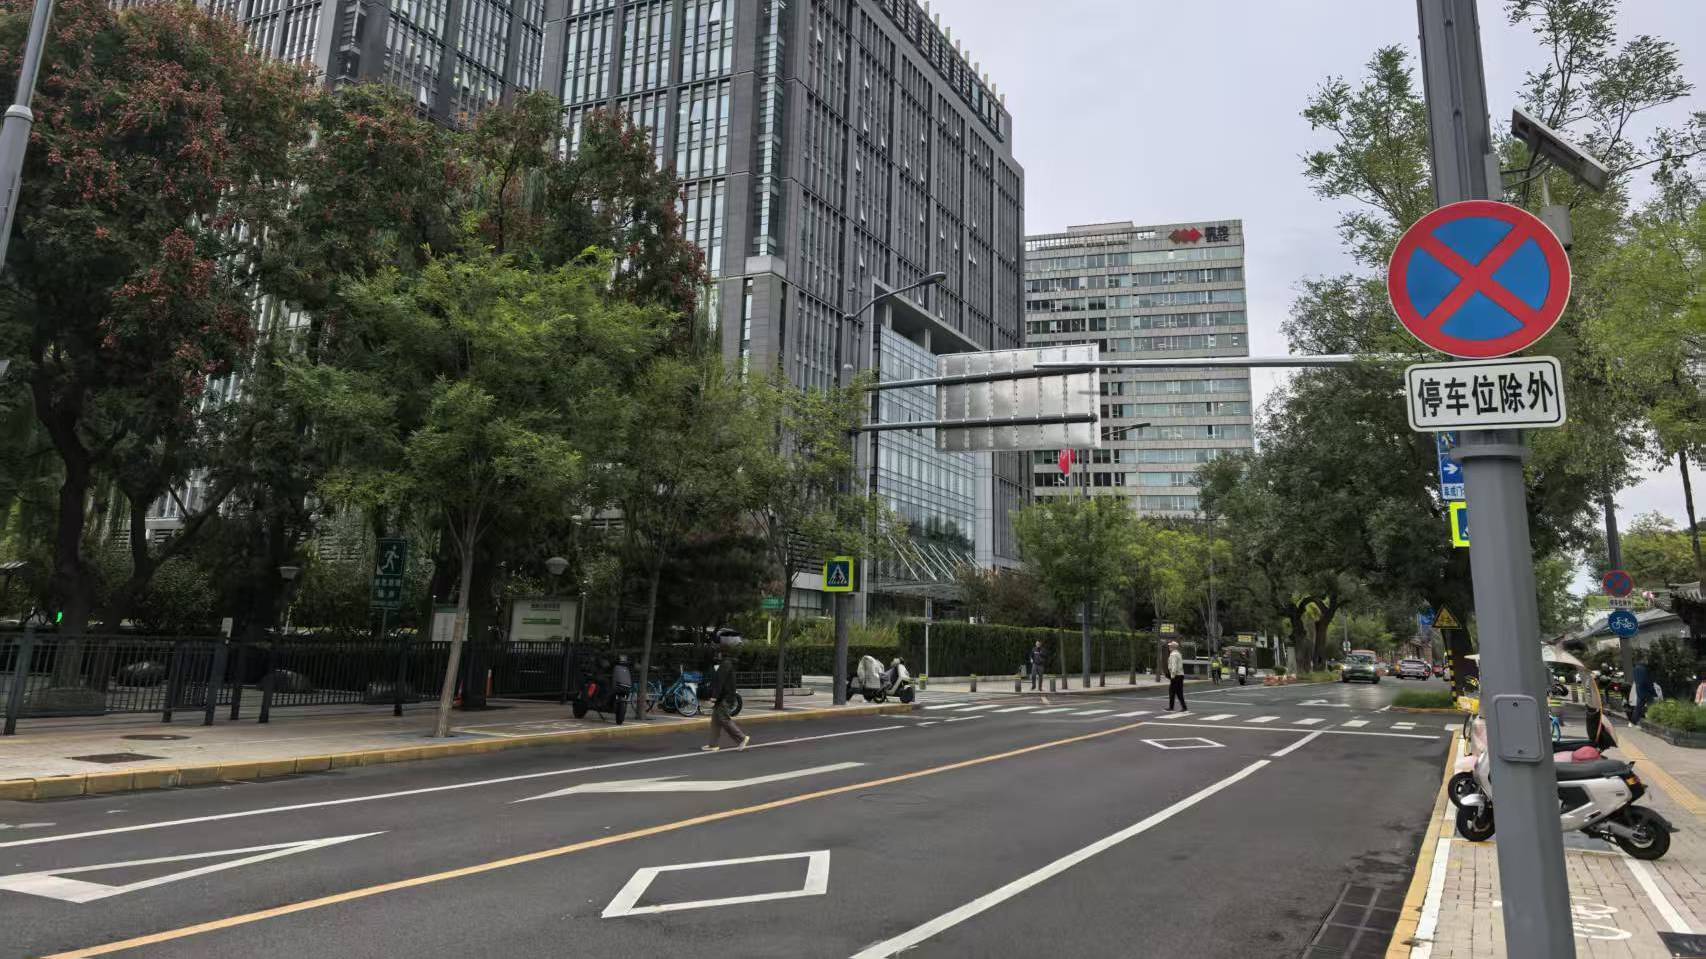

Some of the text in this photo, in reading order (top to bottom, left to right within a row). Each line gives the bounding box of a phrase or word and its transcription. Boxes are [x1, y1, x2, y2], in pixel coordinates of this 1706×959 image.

[1418, 371, 1553, 417] 停车位除外
